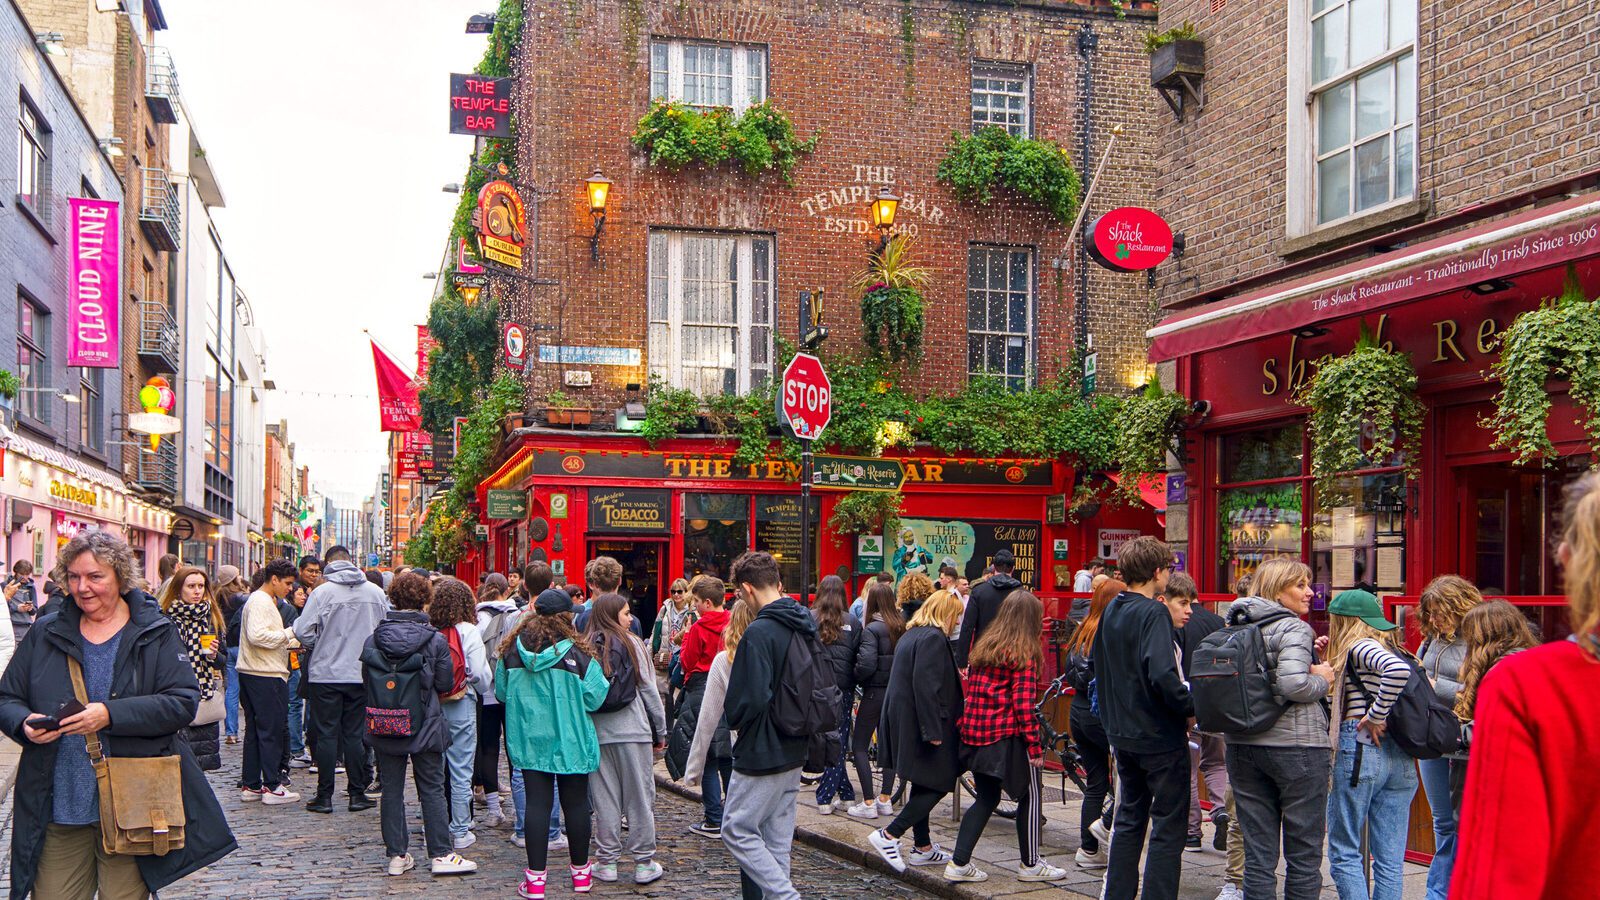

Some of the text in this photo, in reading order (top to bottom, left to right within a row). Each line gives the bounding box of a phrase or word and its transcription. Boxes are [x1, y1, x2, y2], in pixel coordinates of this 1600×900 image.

[465, 79, 495, 94] THE
[451, 96, 509, 113] TEMPLE
[466, 115, 495, 130] BAR
[852, 165, 896, 184] THE
[800, 186, 944, 225] TEMPL BAR
[78, 205, 109, 261] NINE
[824, 217, 872, 234] ESTD.
[1108, 221, 1143, 245] Shack
[1120, 221, 1132, 230] The
[493, 239, 515, 253] DUBLIN
[1126, 242, 1167, 253] Restaurant
[488, 250, 520, 266] LIVE MUSIC
[1311, 295, 1329, 311] The
[1330, 289, 1357, 308] Shack
[1359, 274, 1414, 300] Restaurant
[1424, 249, 1498, 283] Traditionally
[1501, 238, 1530, 263] Irish
[1532, 235, 1564, 254] Since
[1568, 226, 1598, 246] 1996
[78, 269, 108, 344] CLOUD
[785, 378, 829, 414] STOP
[381, 406, 418, 415] TEMPLE
[565, 459, 580, 469] 48
[665, 458, 732, 478] THE
[906, 463, 944, 482] AR
[821, 463, 831, 475] The
[867, 464, 897, 483] Reserve
[1008, 469, 1022, 480] 48
[600, 504, 659, 525] TOBACCO
[766, 505, 797, 514] TEMPLE
[935, 525, 958, 535] THE
[1017, 527, 1036, 541] 1840
[924, 535, 968, 546] TEMPLE
[934, 545, 958, 556] BAR
[1012, 543, 1035, 557] THE
[1021, 571, 1034, 584] OF
